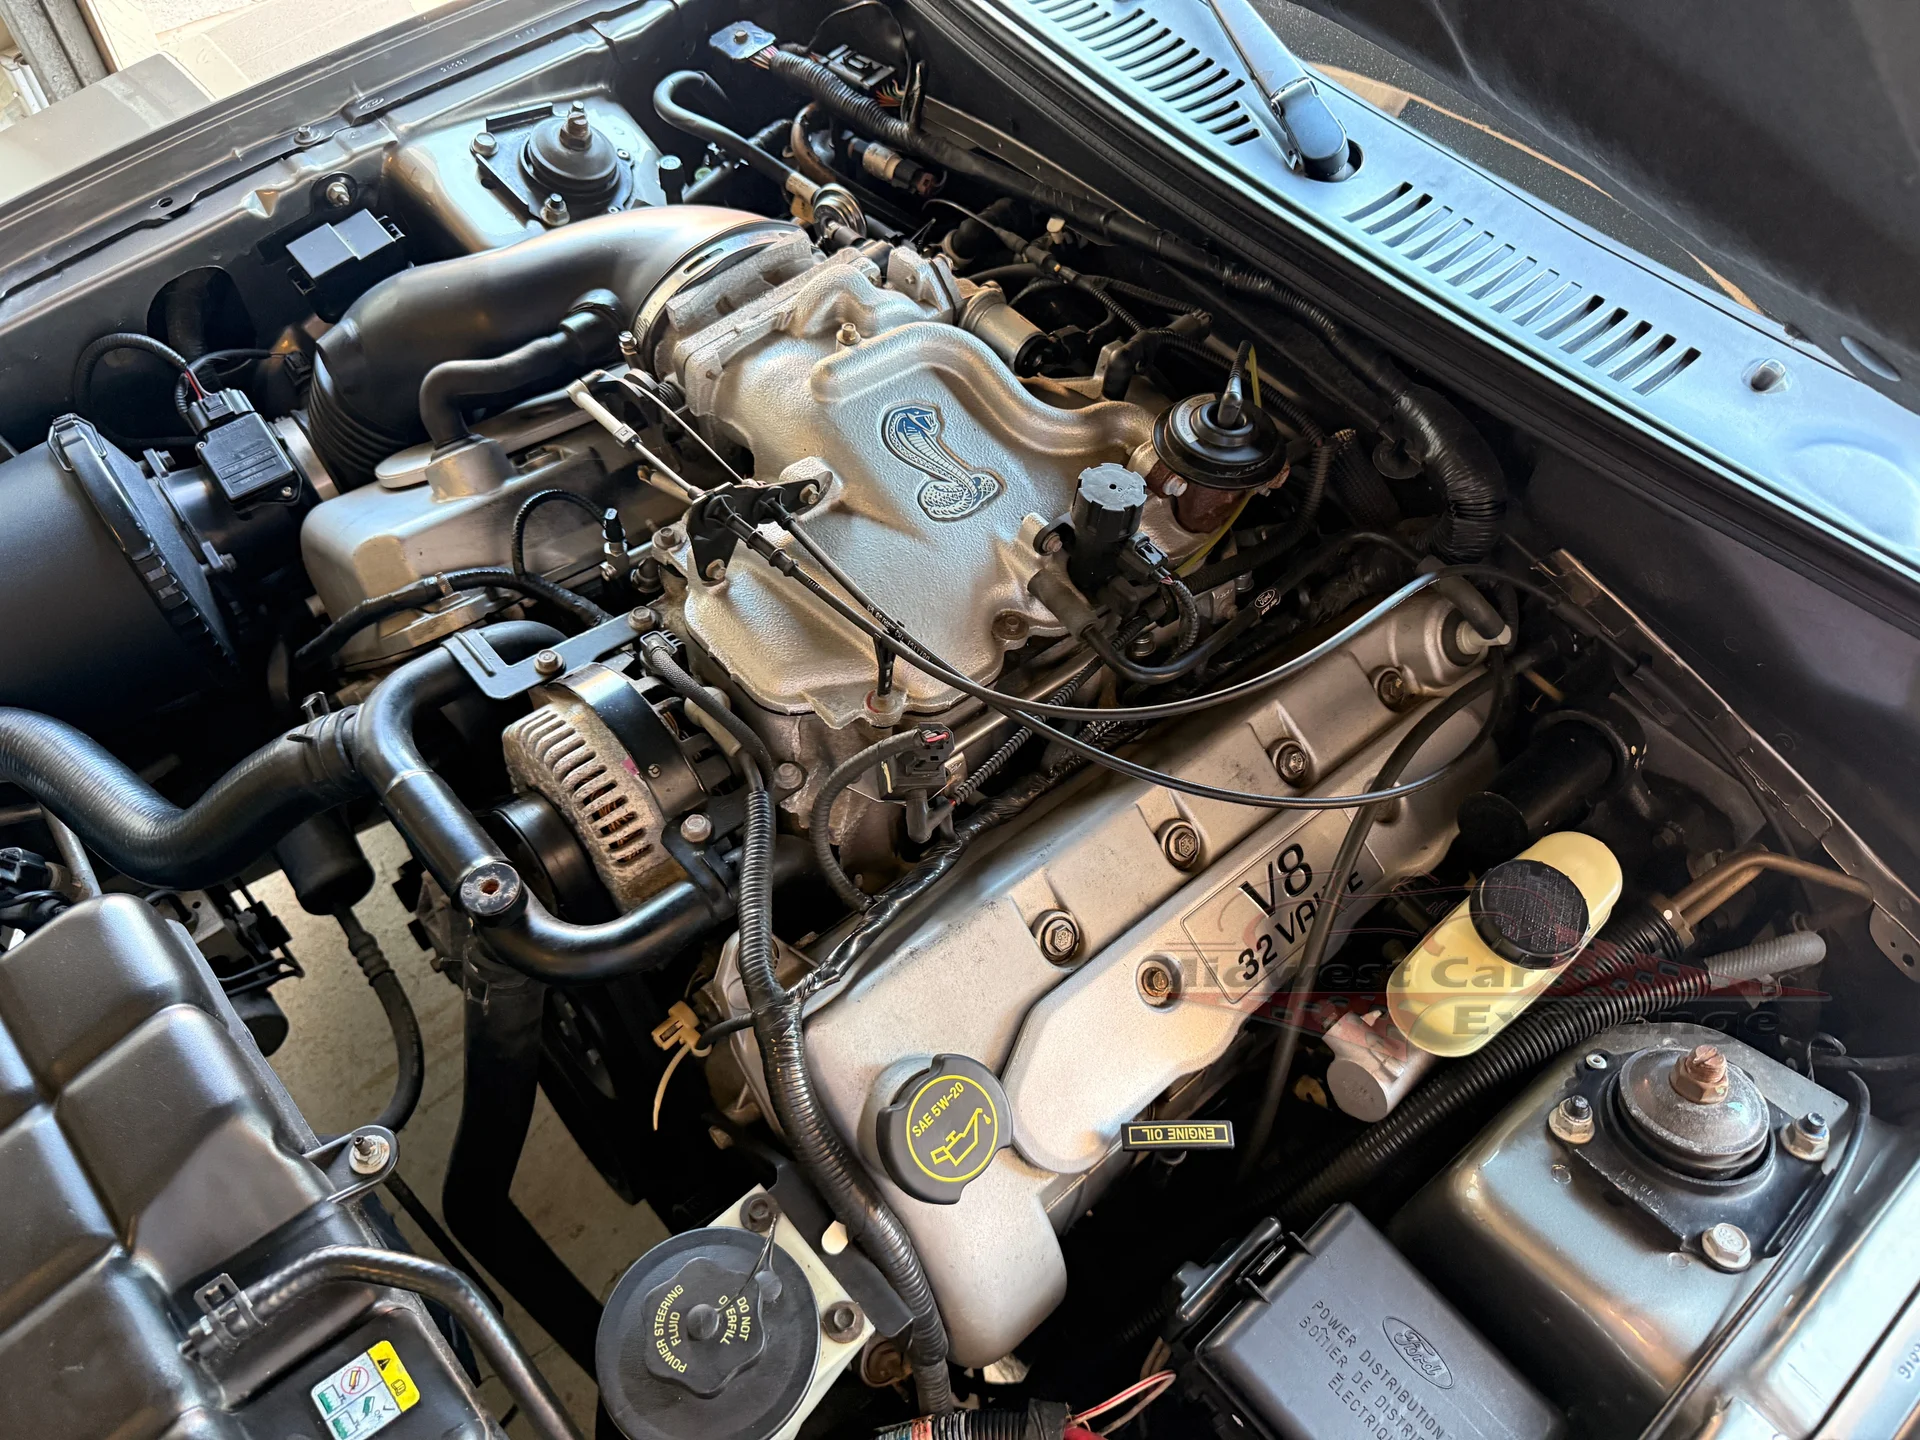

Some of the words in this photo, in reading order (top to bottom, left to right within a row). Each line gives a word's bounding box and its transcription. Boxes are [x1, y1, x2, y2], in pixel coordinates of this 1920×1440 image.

[1238, 842, 1313, 918] V8
[1237, 934, 1278, 981] 32
[1274, 871, 1364, 944] VAE
[912, 1112, 935, 1137] SAE
[930, 1081, 965, 1117] 5W-20
[1141, 1128, 1164, 1141] OIL
[1167, 1127, 1216, 1140] ENGINE
[653, 1284, 684, 1337] STEERING
[668, 1311, 682, 1347] FLUID
[718, 1295, 738, 1345] OERFILL
[736, 1296, 750, 1314] DO
[739, 1316, 752, 1342] NOT
[655, 1338, 688, 1374] POWER
[1299, 1316, 1348, 1369] BOÎTIER
[1351, 1370, 1373, 1394] DE
[1311, 1300, 1357, 1348] POWER
[1358, 1349, 1445, 1440] DISTRIBUTION
[1393, 1329, 1442, 1377] Ford
[374, 1409, 385, 1421] OK
